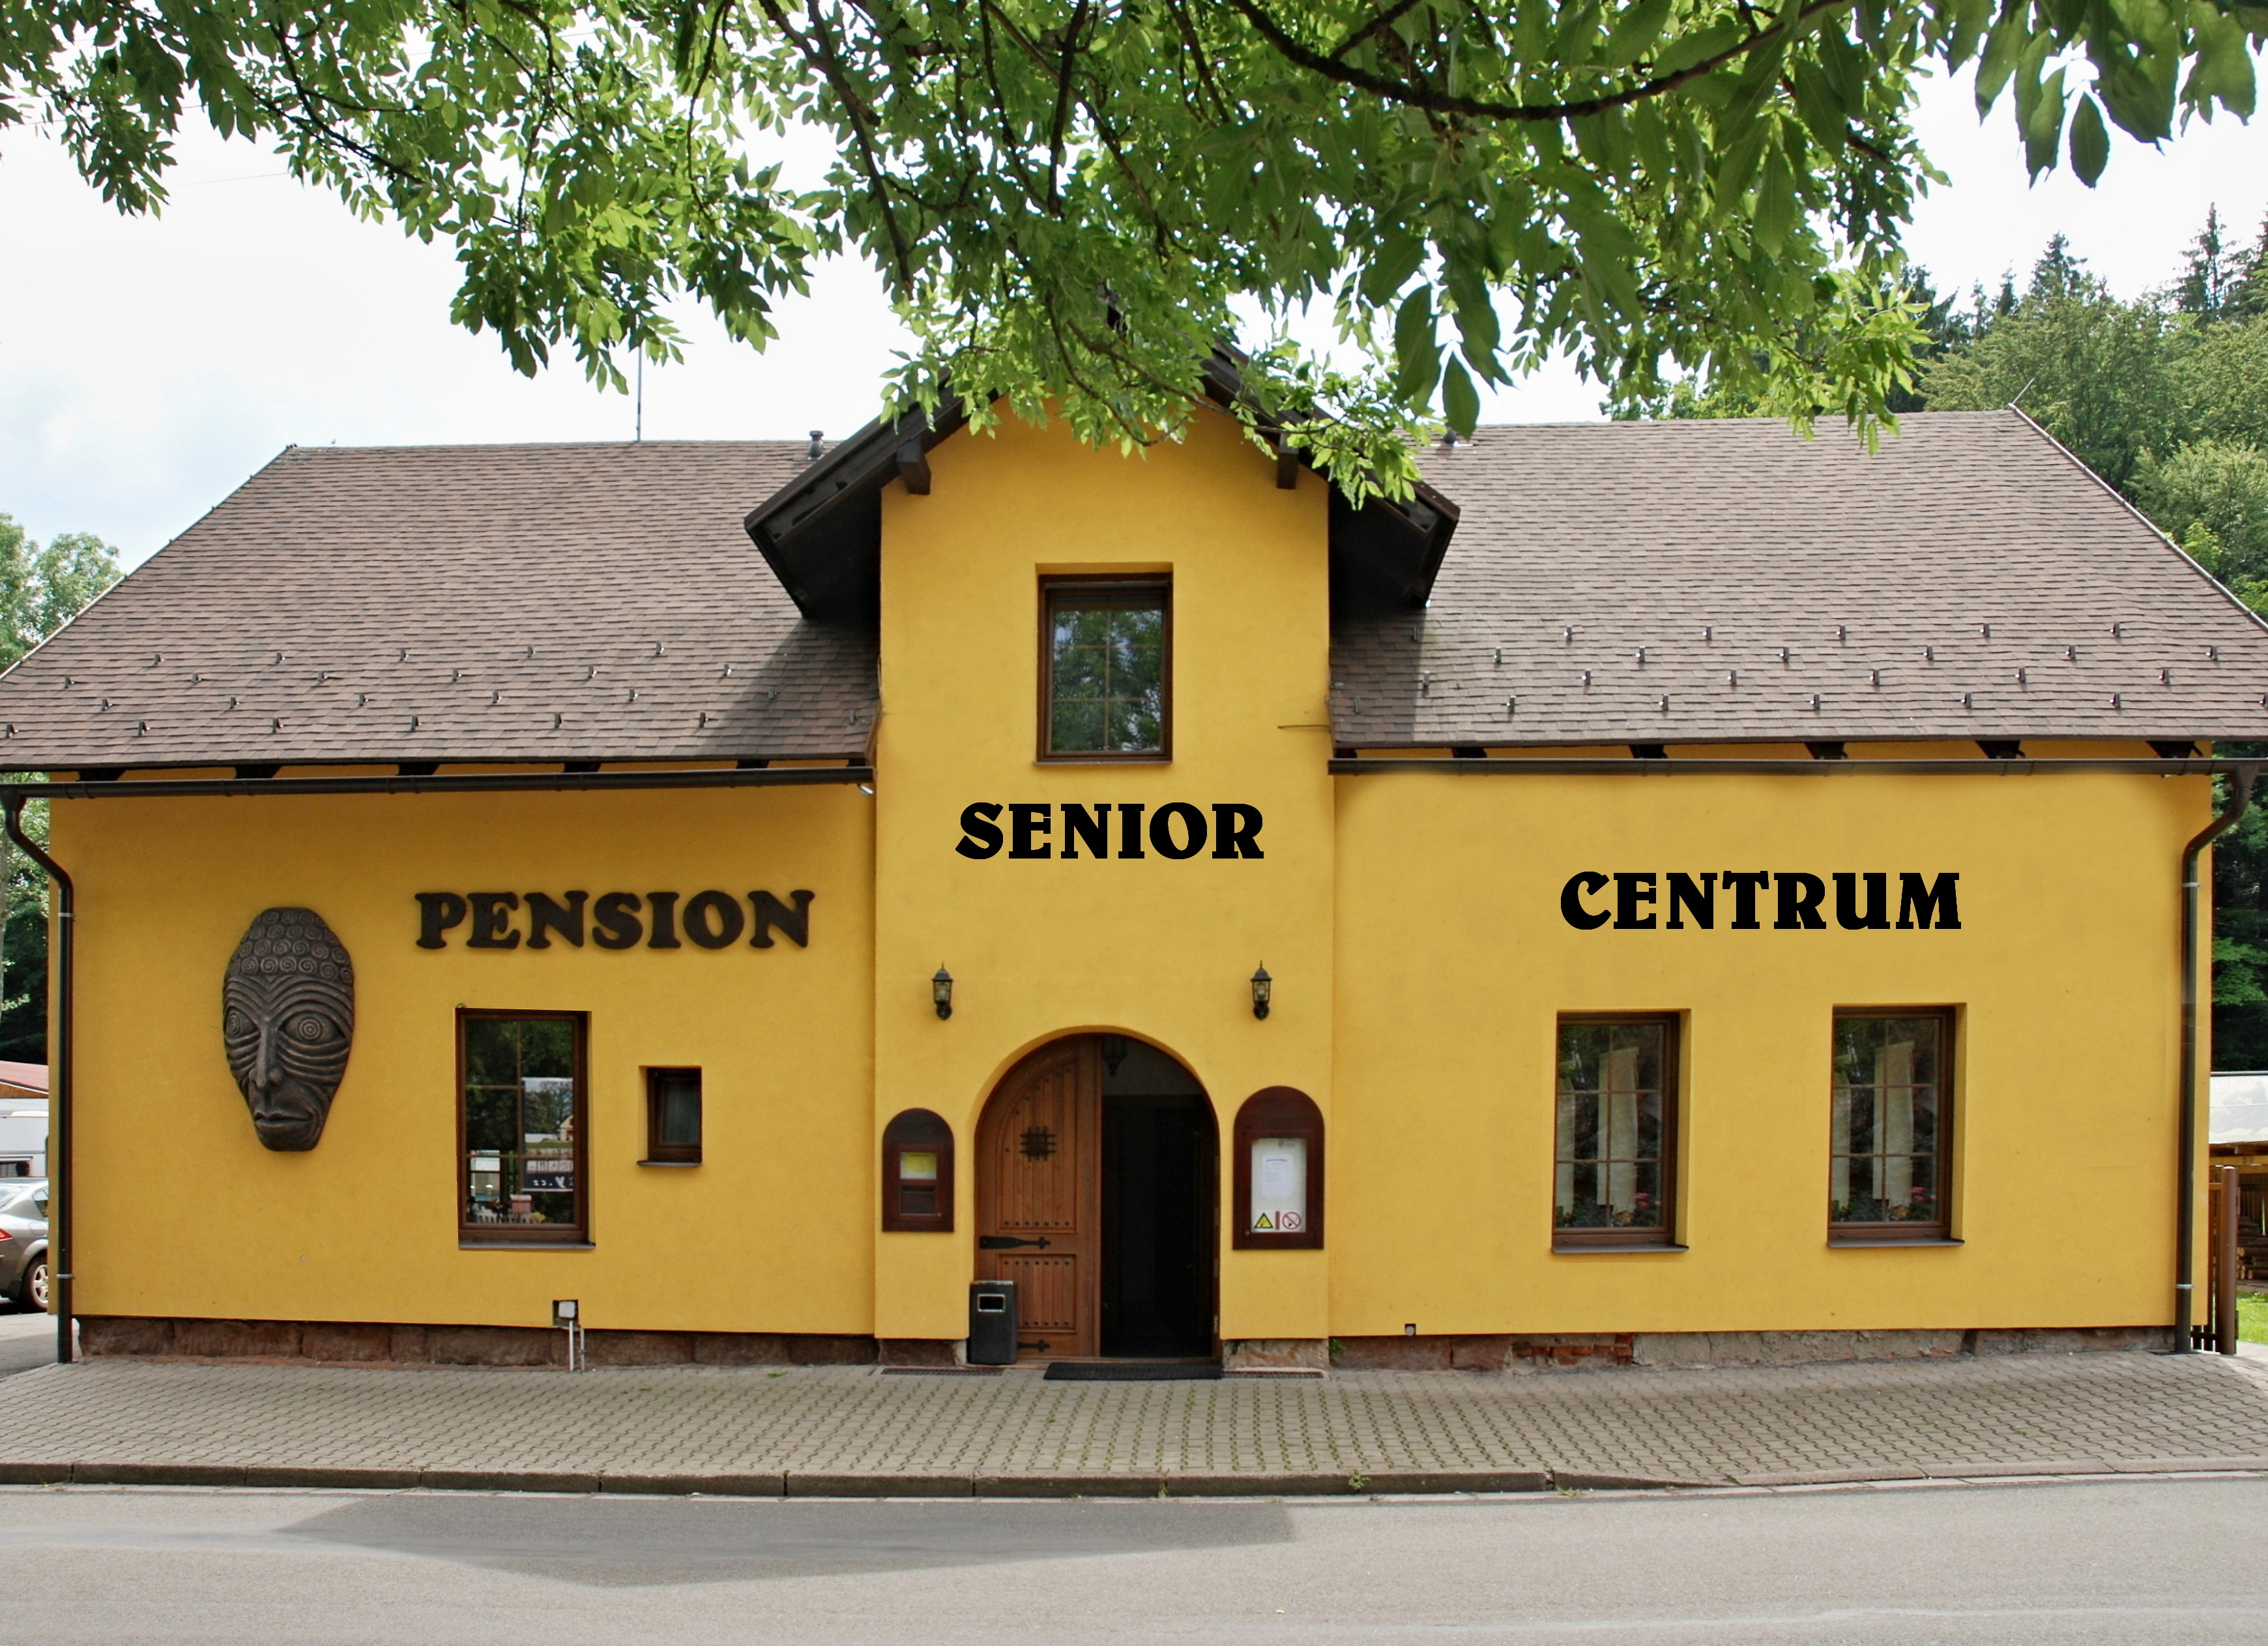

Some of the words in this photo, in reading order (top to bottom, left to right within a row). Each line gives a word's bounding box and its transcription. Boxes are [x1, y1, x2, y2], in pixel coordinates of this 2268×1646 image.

[955, 802, 1264, 860] SENIOR
[414, 890, 815, 950] PENSION
[1560, 871, 1962, 930] CENTRUM
